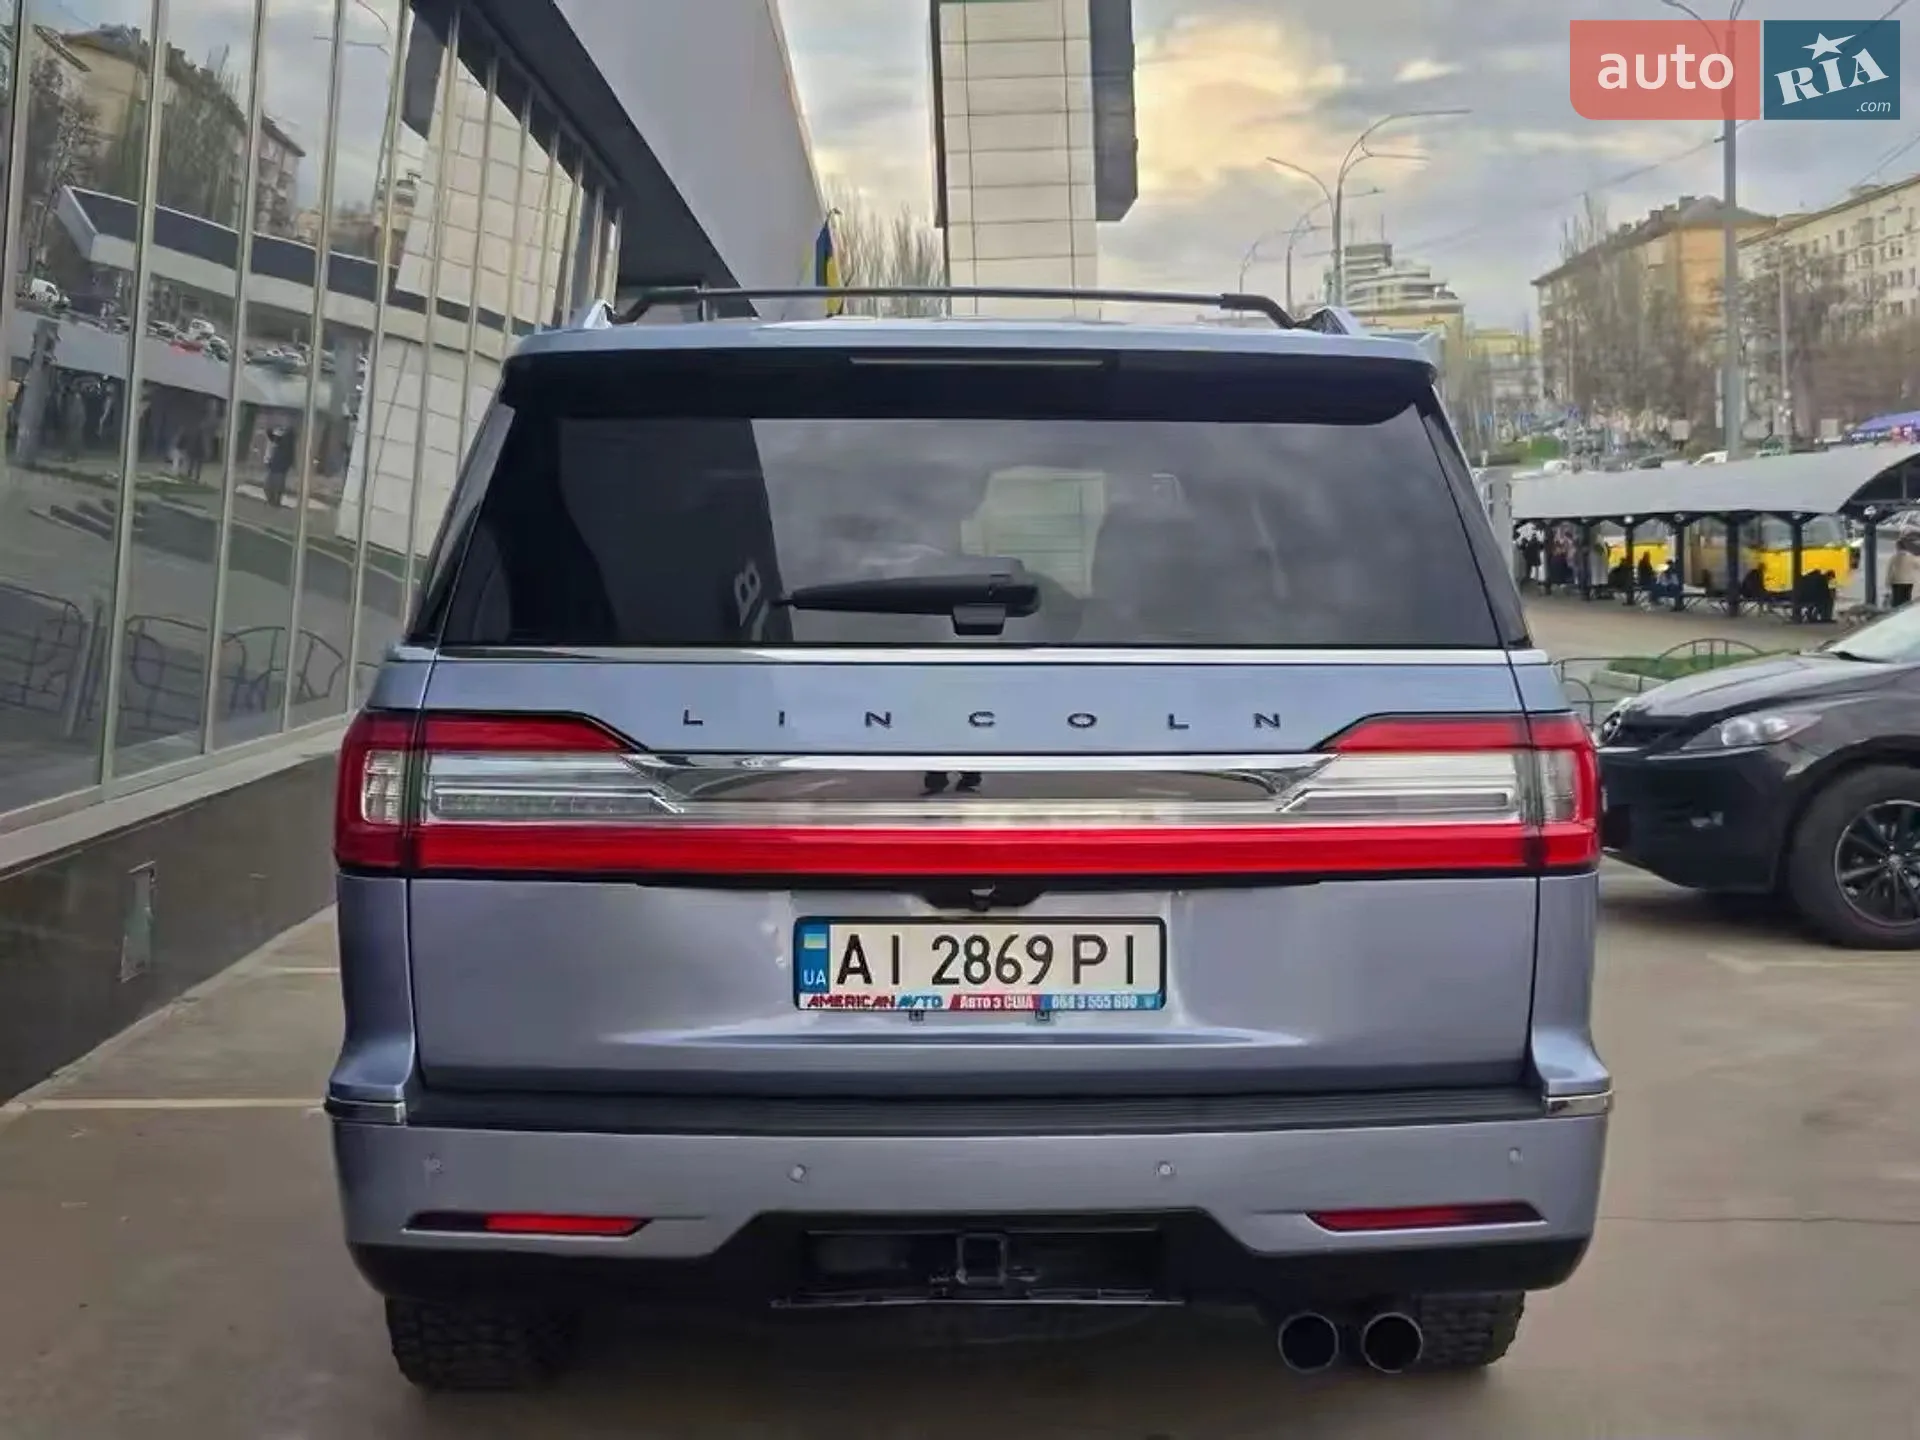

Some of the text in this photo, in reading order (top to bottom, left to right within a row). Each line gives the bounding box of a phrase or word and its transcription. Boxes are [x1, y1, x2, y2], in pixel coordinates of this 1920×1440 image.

[683, 710, 1280, 730] LINCOLN
[836, 934, 1134, 985] AI 2869 PI
[803, 970, 826, 985] UA
[807, 995, 895, 1007] AMERICAN
